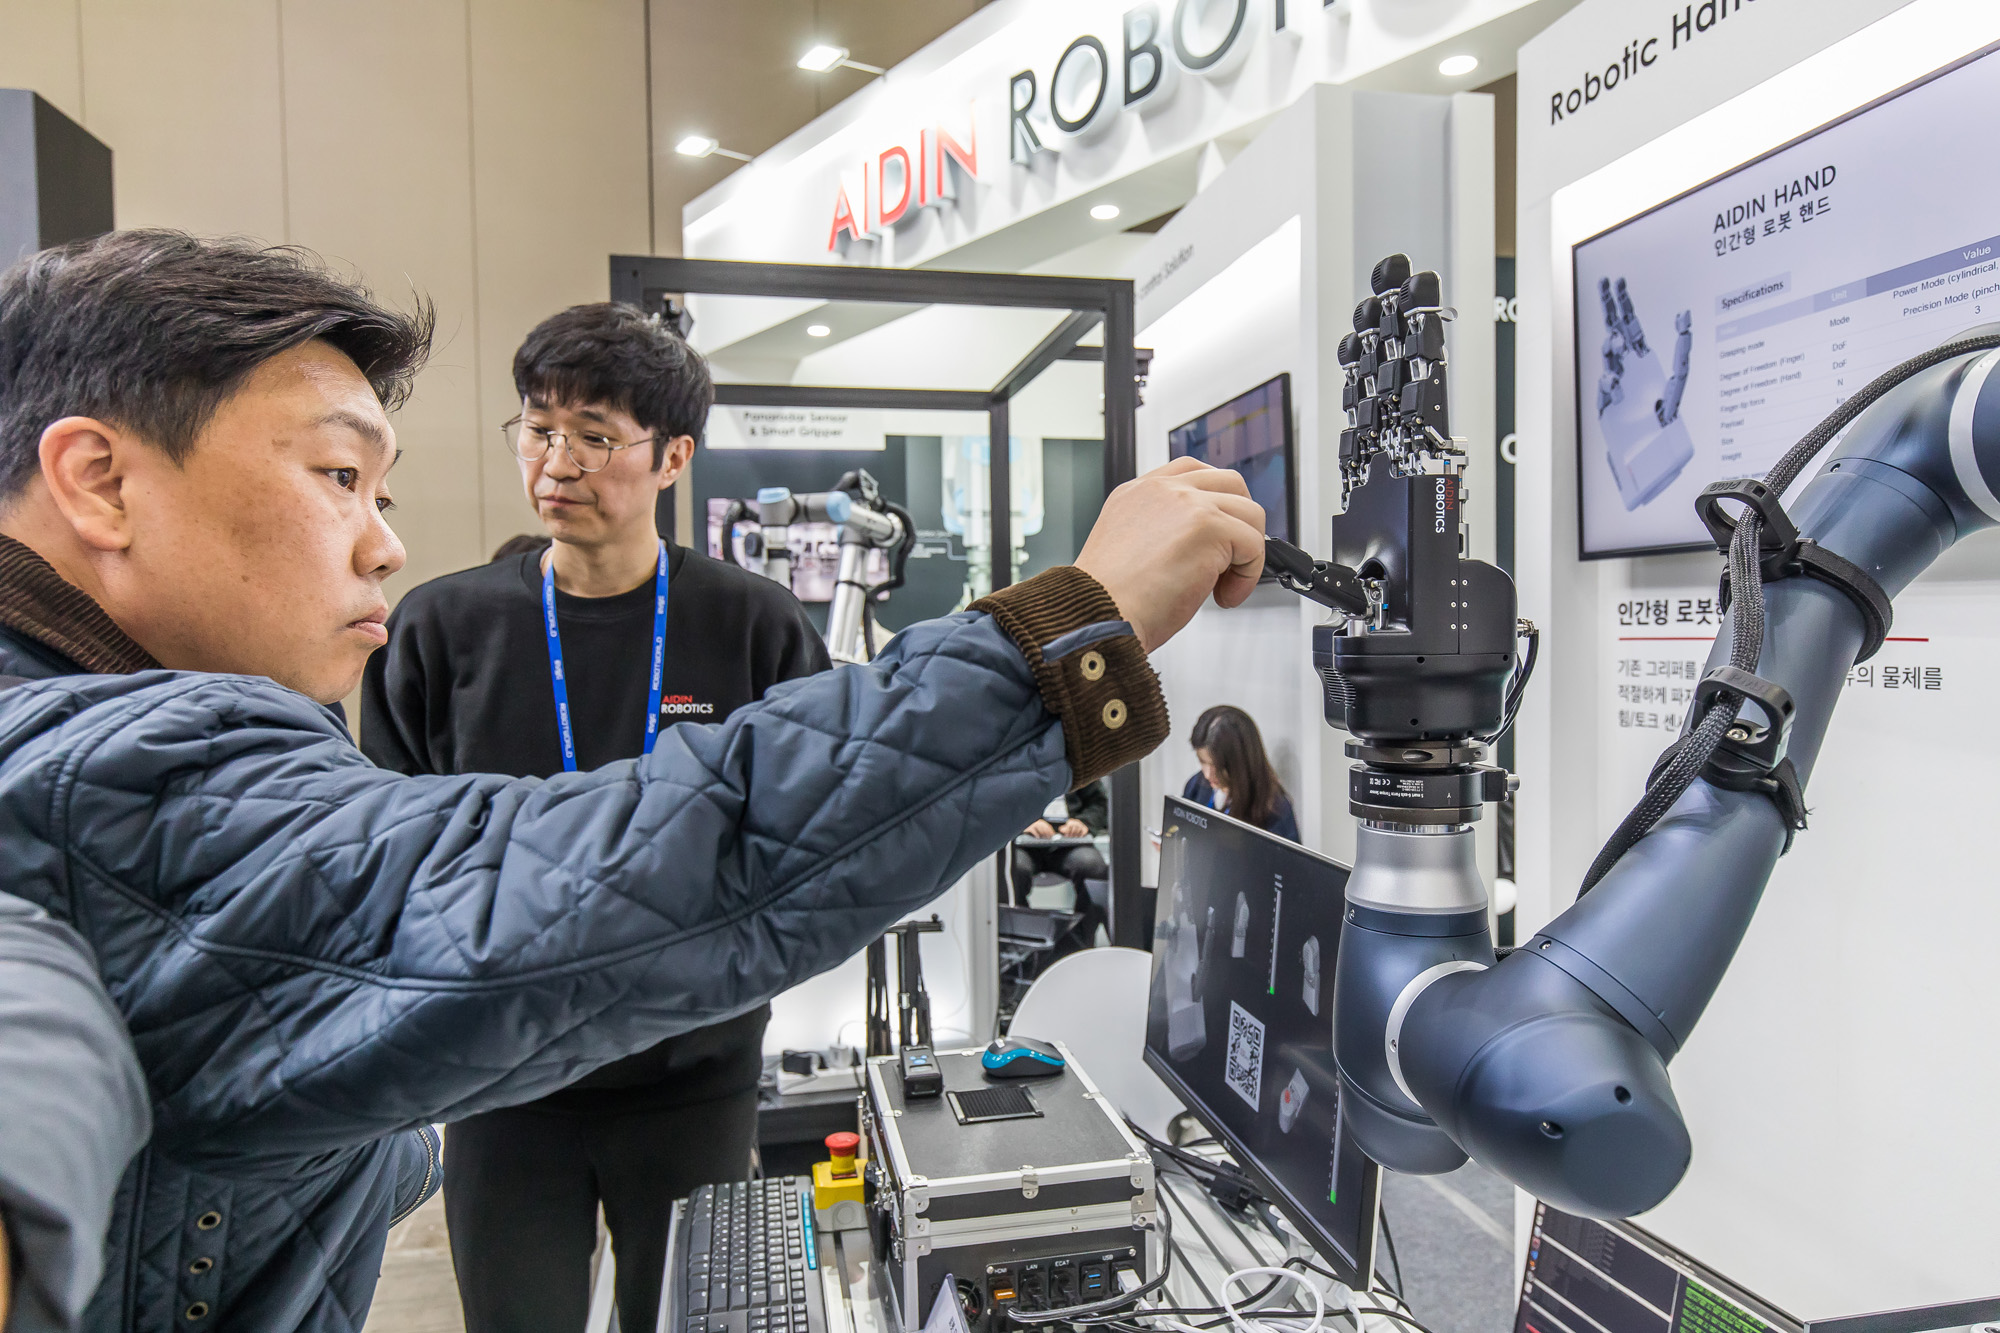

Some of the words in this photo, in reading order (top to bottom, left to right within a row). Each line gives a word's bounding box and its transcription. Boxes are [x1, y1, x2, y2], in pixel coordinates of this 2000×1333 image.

[1551, 37, 1658, 125] Robotic
[828, 98, 977, 252] AIDIN
[1010, 0, 1335, 164] ROBO
[1713, 194, 1766, 234] AIDIN
[1774, 164, 1837, 208] HAND
[1714, 225, 1756, 257] 인간형
[1762, 210, 1792, 237] 로봇
[1799, 195, 1832, 223] 핸드
[1962, 246, 1992, 261] Value
[1892, 285, 1919, 299] Power
[1920, 277, 1946, 291] Mode
[1946, 260, 1999, 285] (cylindrical,
[1721, 280, 1785, 311] Specifications
[1902, 299, 1943, 317] Precision
[1943, 292, 1970, 306] Mode
[1829, 315, 1850, 328] Mode
[1974, 305, 1982, 315] 3
[1435, 477, 1445, 534] ROBOTICS
[1446, 478, 1454, 510] AIDIN
[1618, 599, 1669, 626] 인간형
[652, 636, 663, 691] ROBOTWORLD
[1618, 659, 1642, 678] 기존
[1645, 660, 1696, 680] 그리퍼를
[1882, 665, 1943, 690] 물체를
[661, 694, 693, 704] AIDIN
[1618, 685, 1667, 704] 적절하게
[660, 703, 714, 714] ROBOTICS
[560, 702, 573, 759] ROBOTWORLD
[1186, 811, 1208, 829] ROBOTICS
